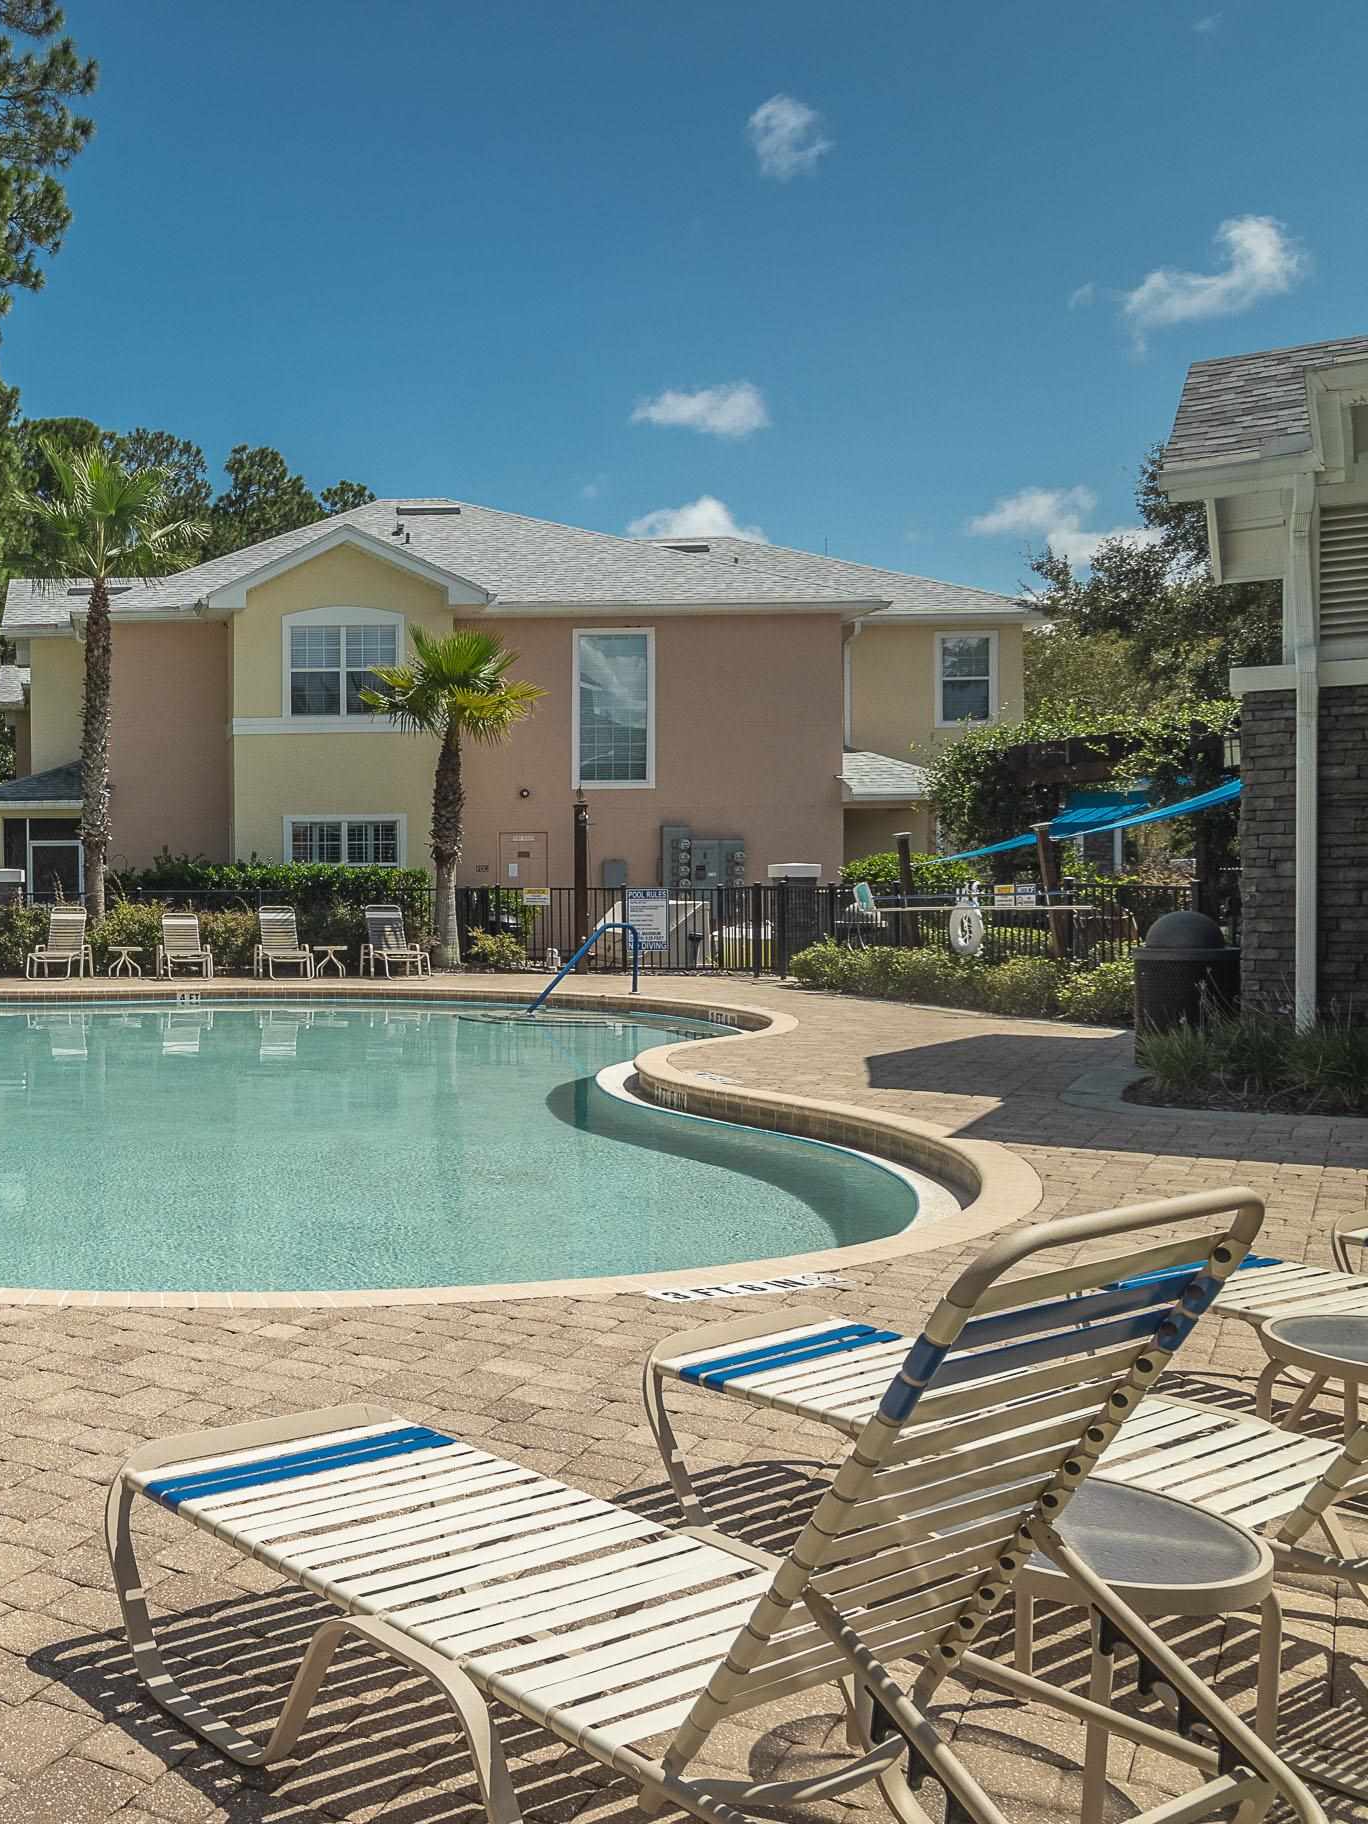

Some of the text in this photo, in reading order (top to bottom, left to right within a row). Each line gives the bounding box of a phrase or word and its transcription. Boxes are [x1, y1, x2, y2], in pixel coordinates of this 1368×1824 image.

[628, 890, 667, 899] POOL RULES
[642, 942, 667, 950] DIVING
[661, 1291, 692, 1300] 3
[736, 1284, 769, 1292] 6
